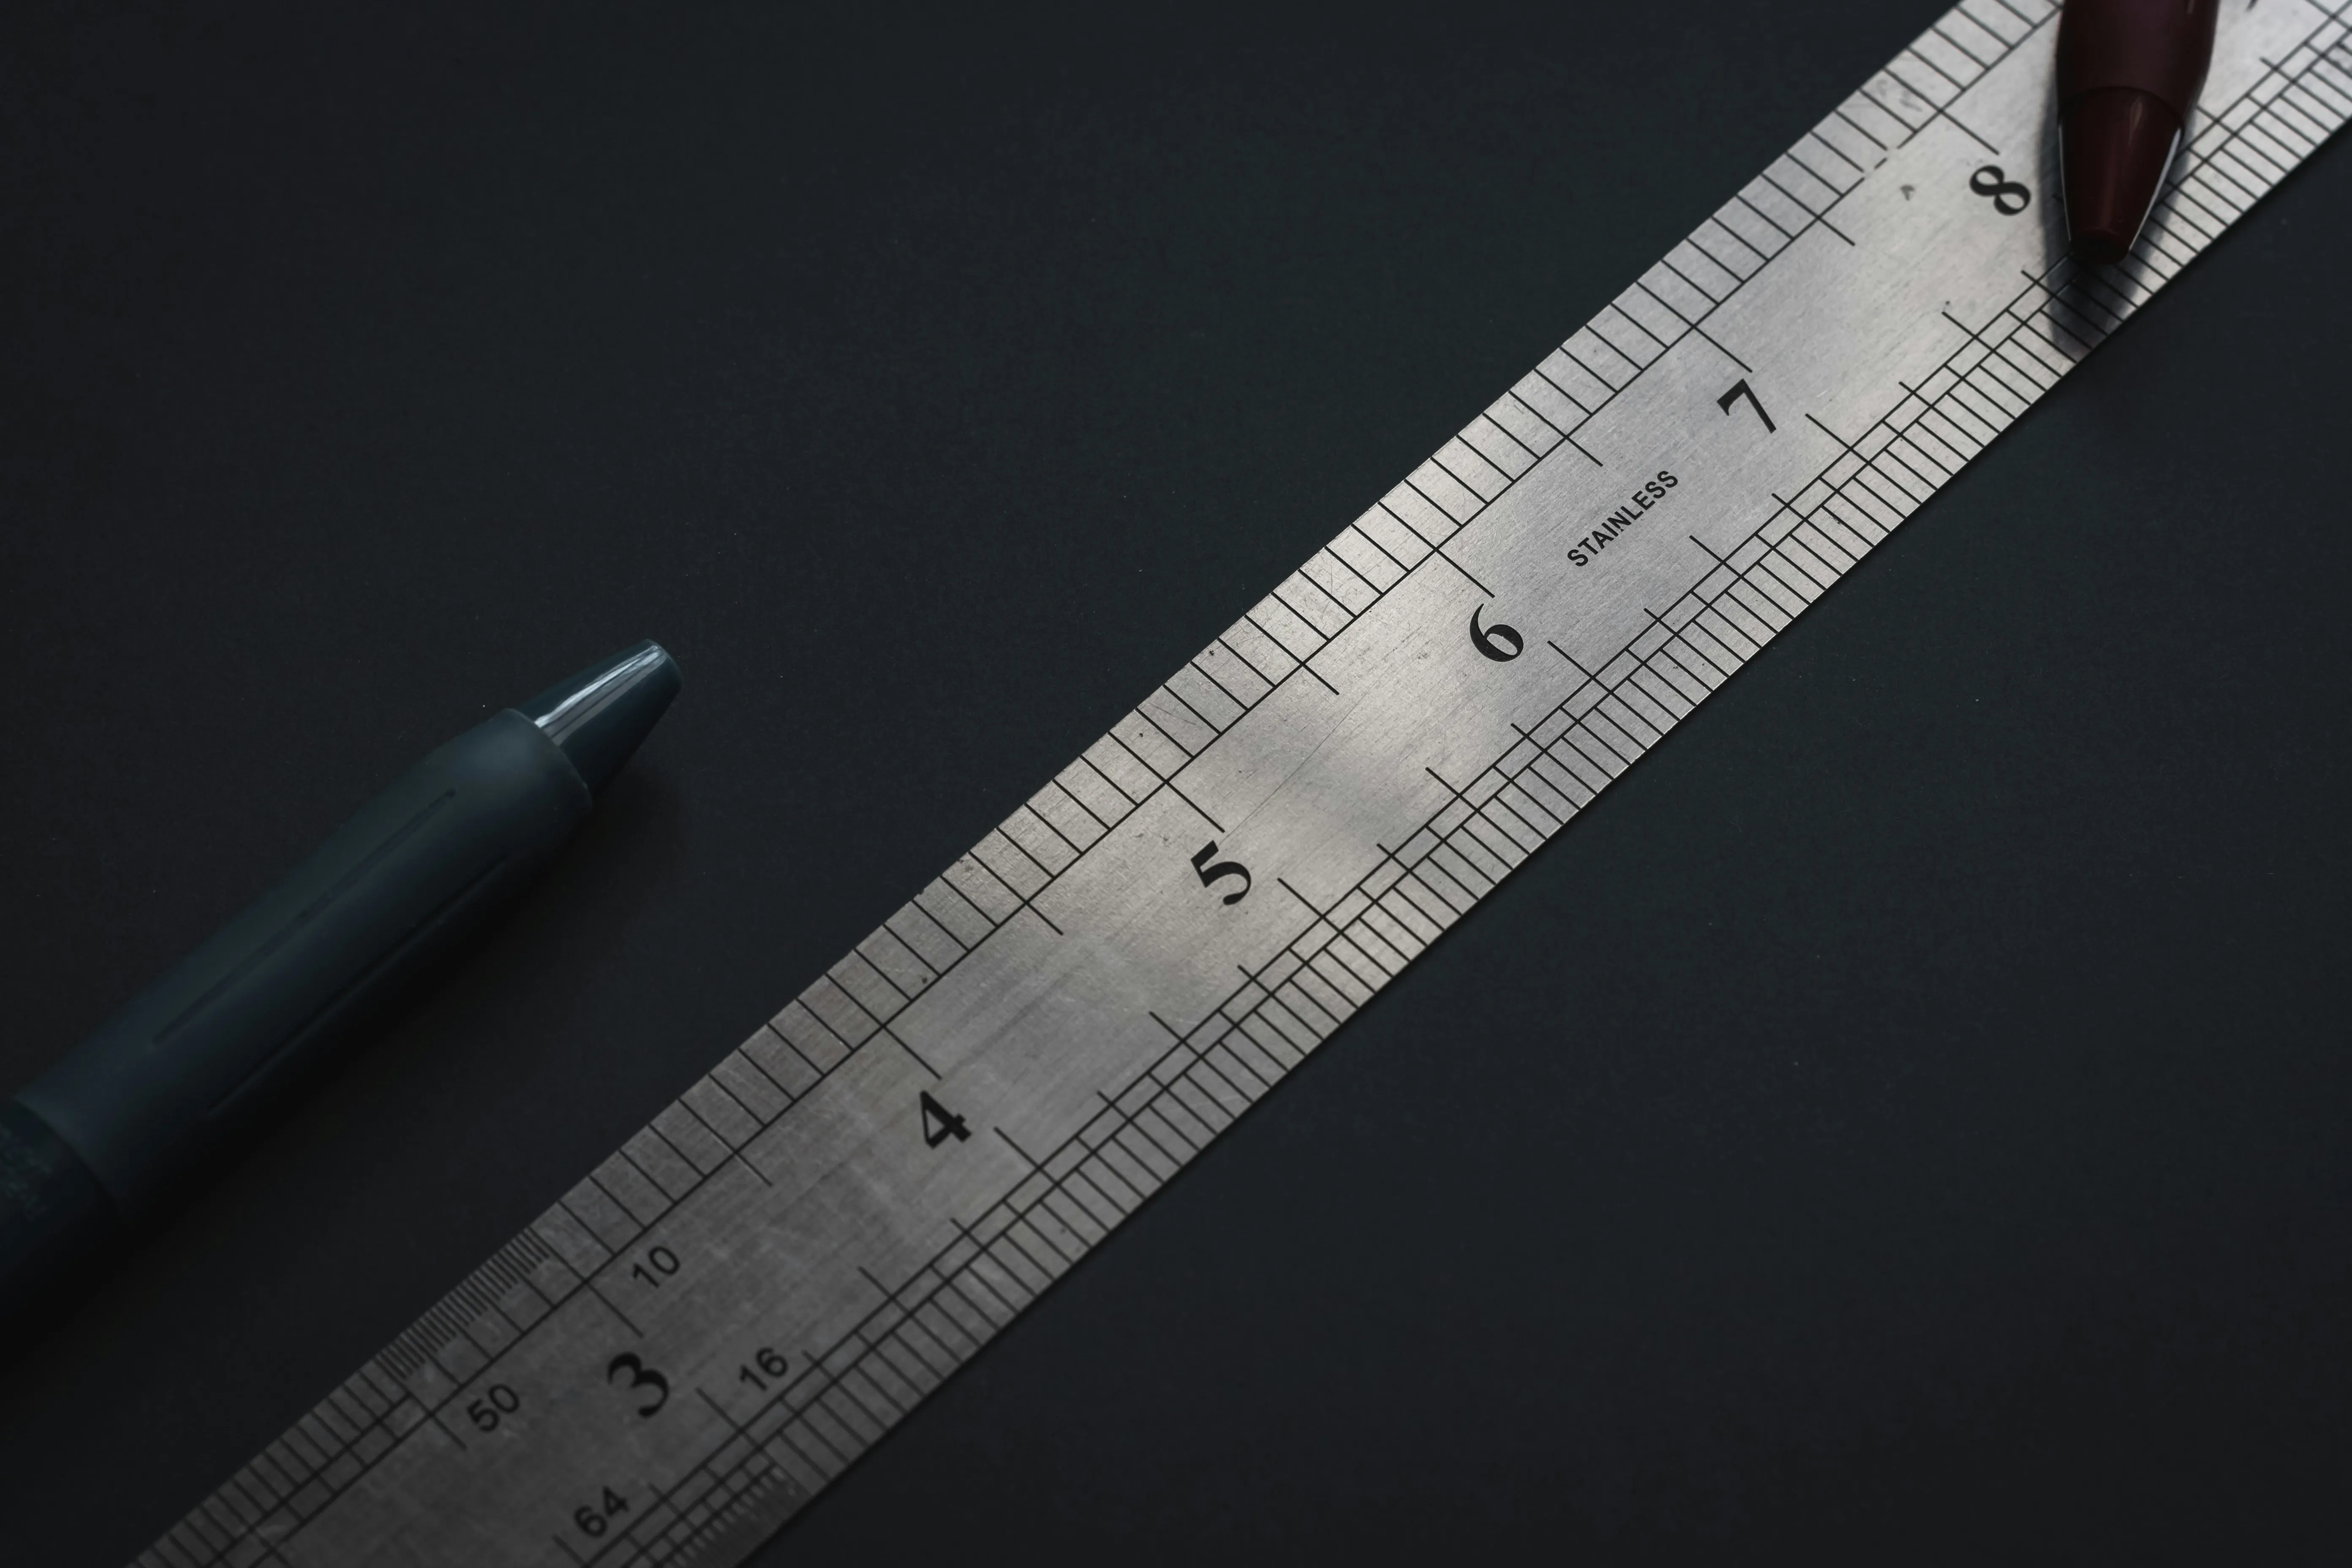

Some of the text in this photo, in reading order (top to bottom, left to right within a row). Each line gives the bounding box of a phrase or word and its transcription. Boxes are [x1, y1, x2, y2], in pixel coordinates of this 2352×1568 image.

[1969, 164, 2032, 217] 8
[1716, 378, 1777, 434] 7
[1567, 470, 1679, 567] STAINLESS
[1469, 603, 1524, 662] 6
[1190, 839, 1252, 906] 5
[919, 1089, 973, 1150] 4
[631, 1244, 681, 1289] 10
[607, 1351, 670, 1419] 3
[738, 1347, 789, 1392] 16
[466, 1383, 520, 1433] 50
[573, 1486, 630, 1538] 64
